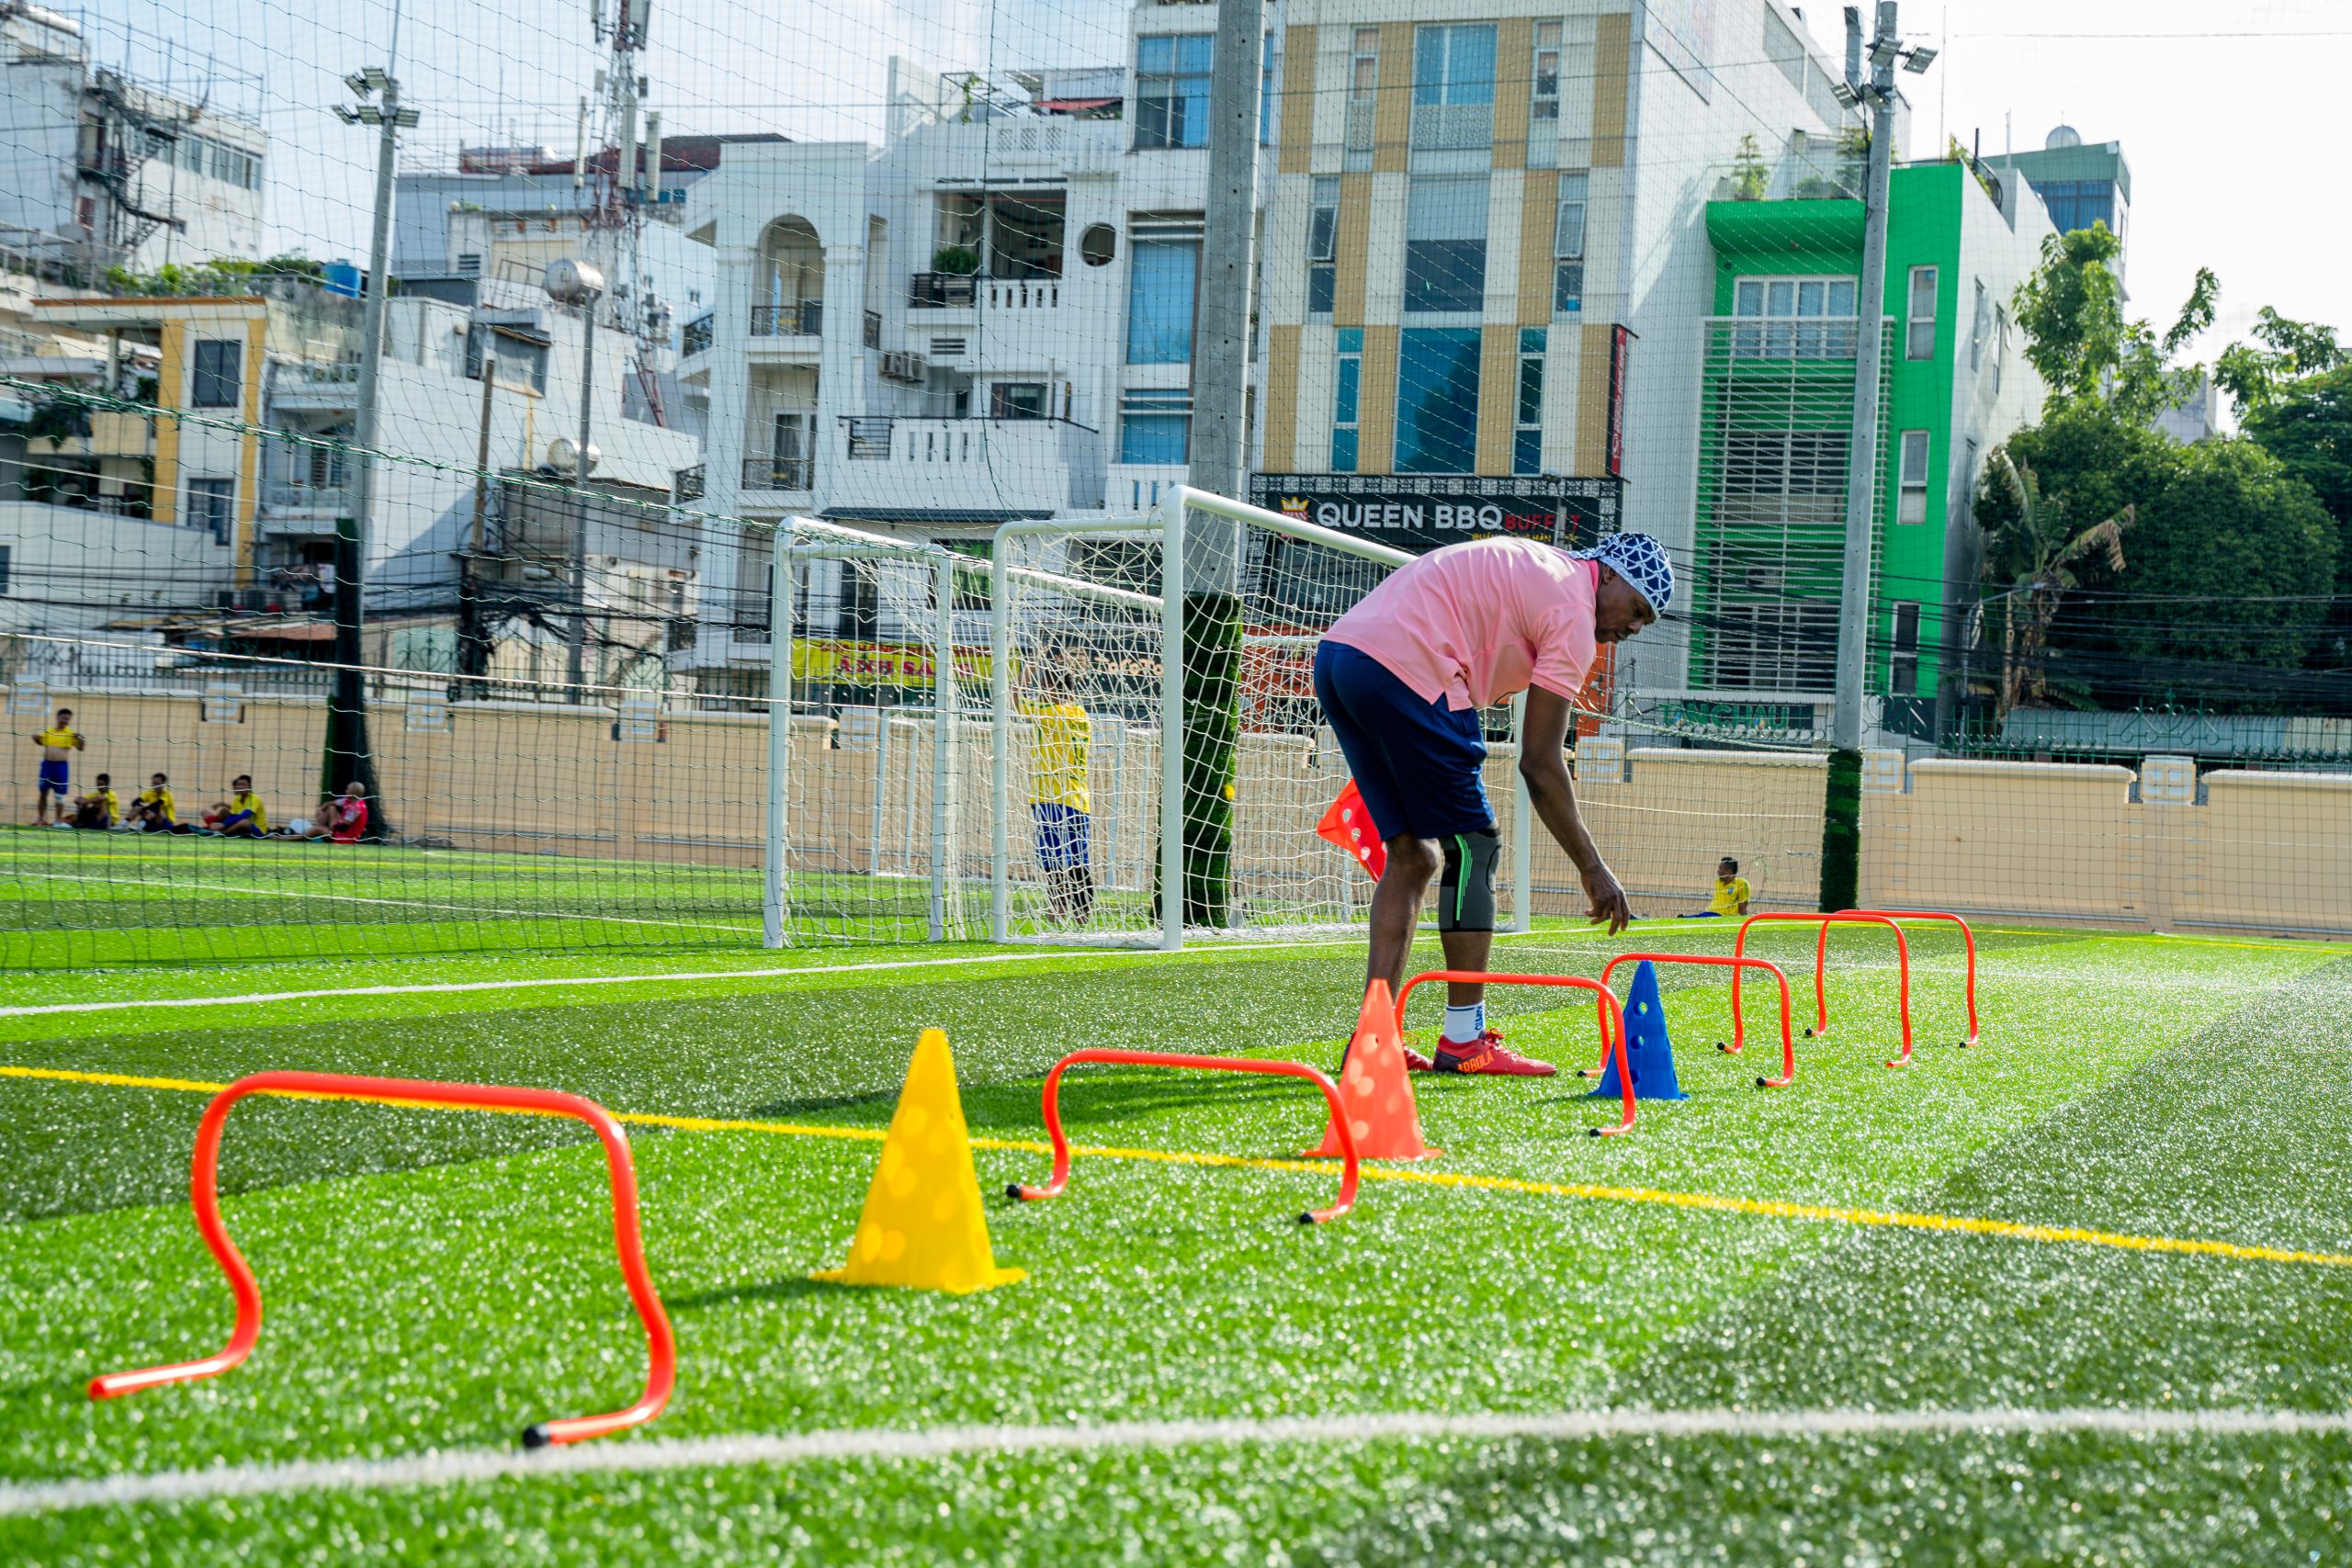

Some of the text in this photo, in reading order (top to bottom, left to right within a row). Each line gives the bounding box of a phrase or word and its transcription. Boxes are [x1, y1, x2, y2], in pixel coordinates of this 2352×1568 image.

[1317, 502, 1581, 531] QUEEN BBQ BUFFT
